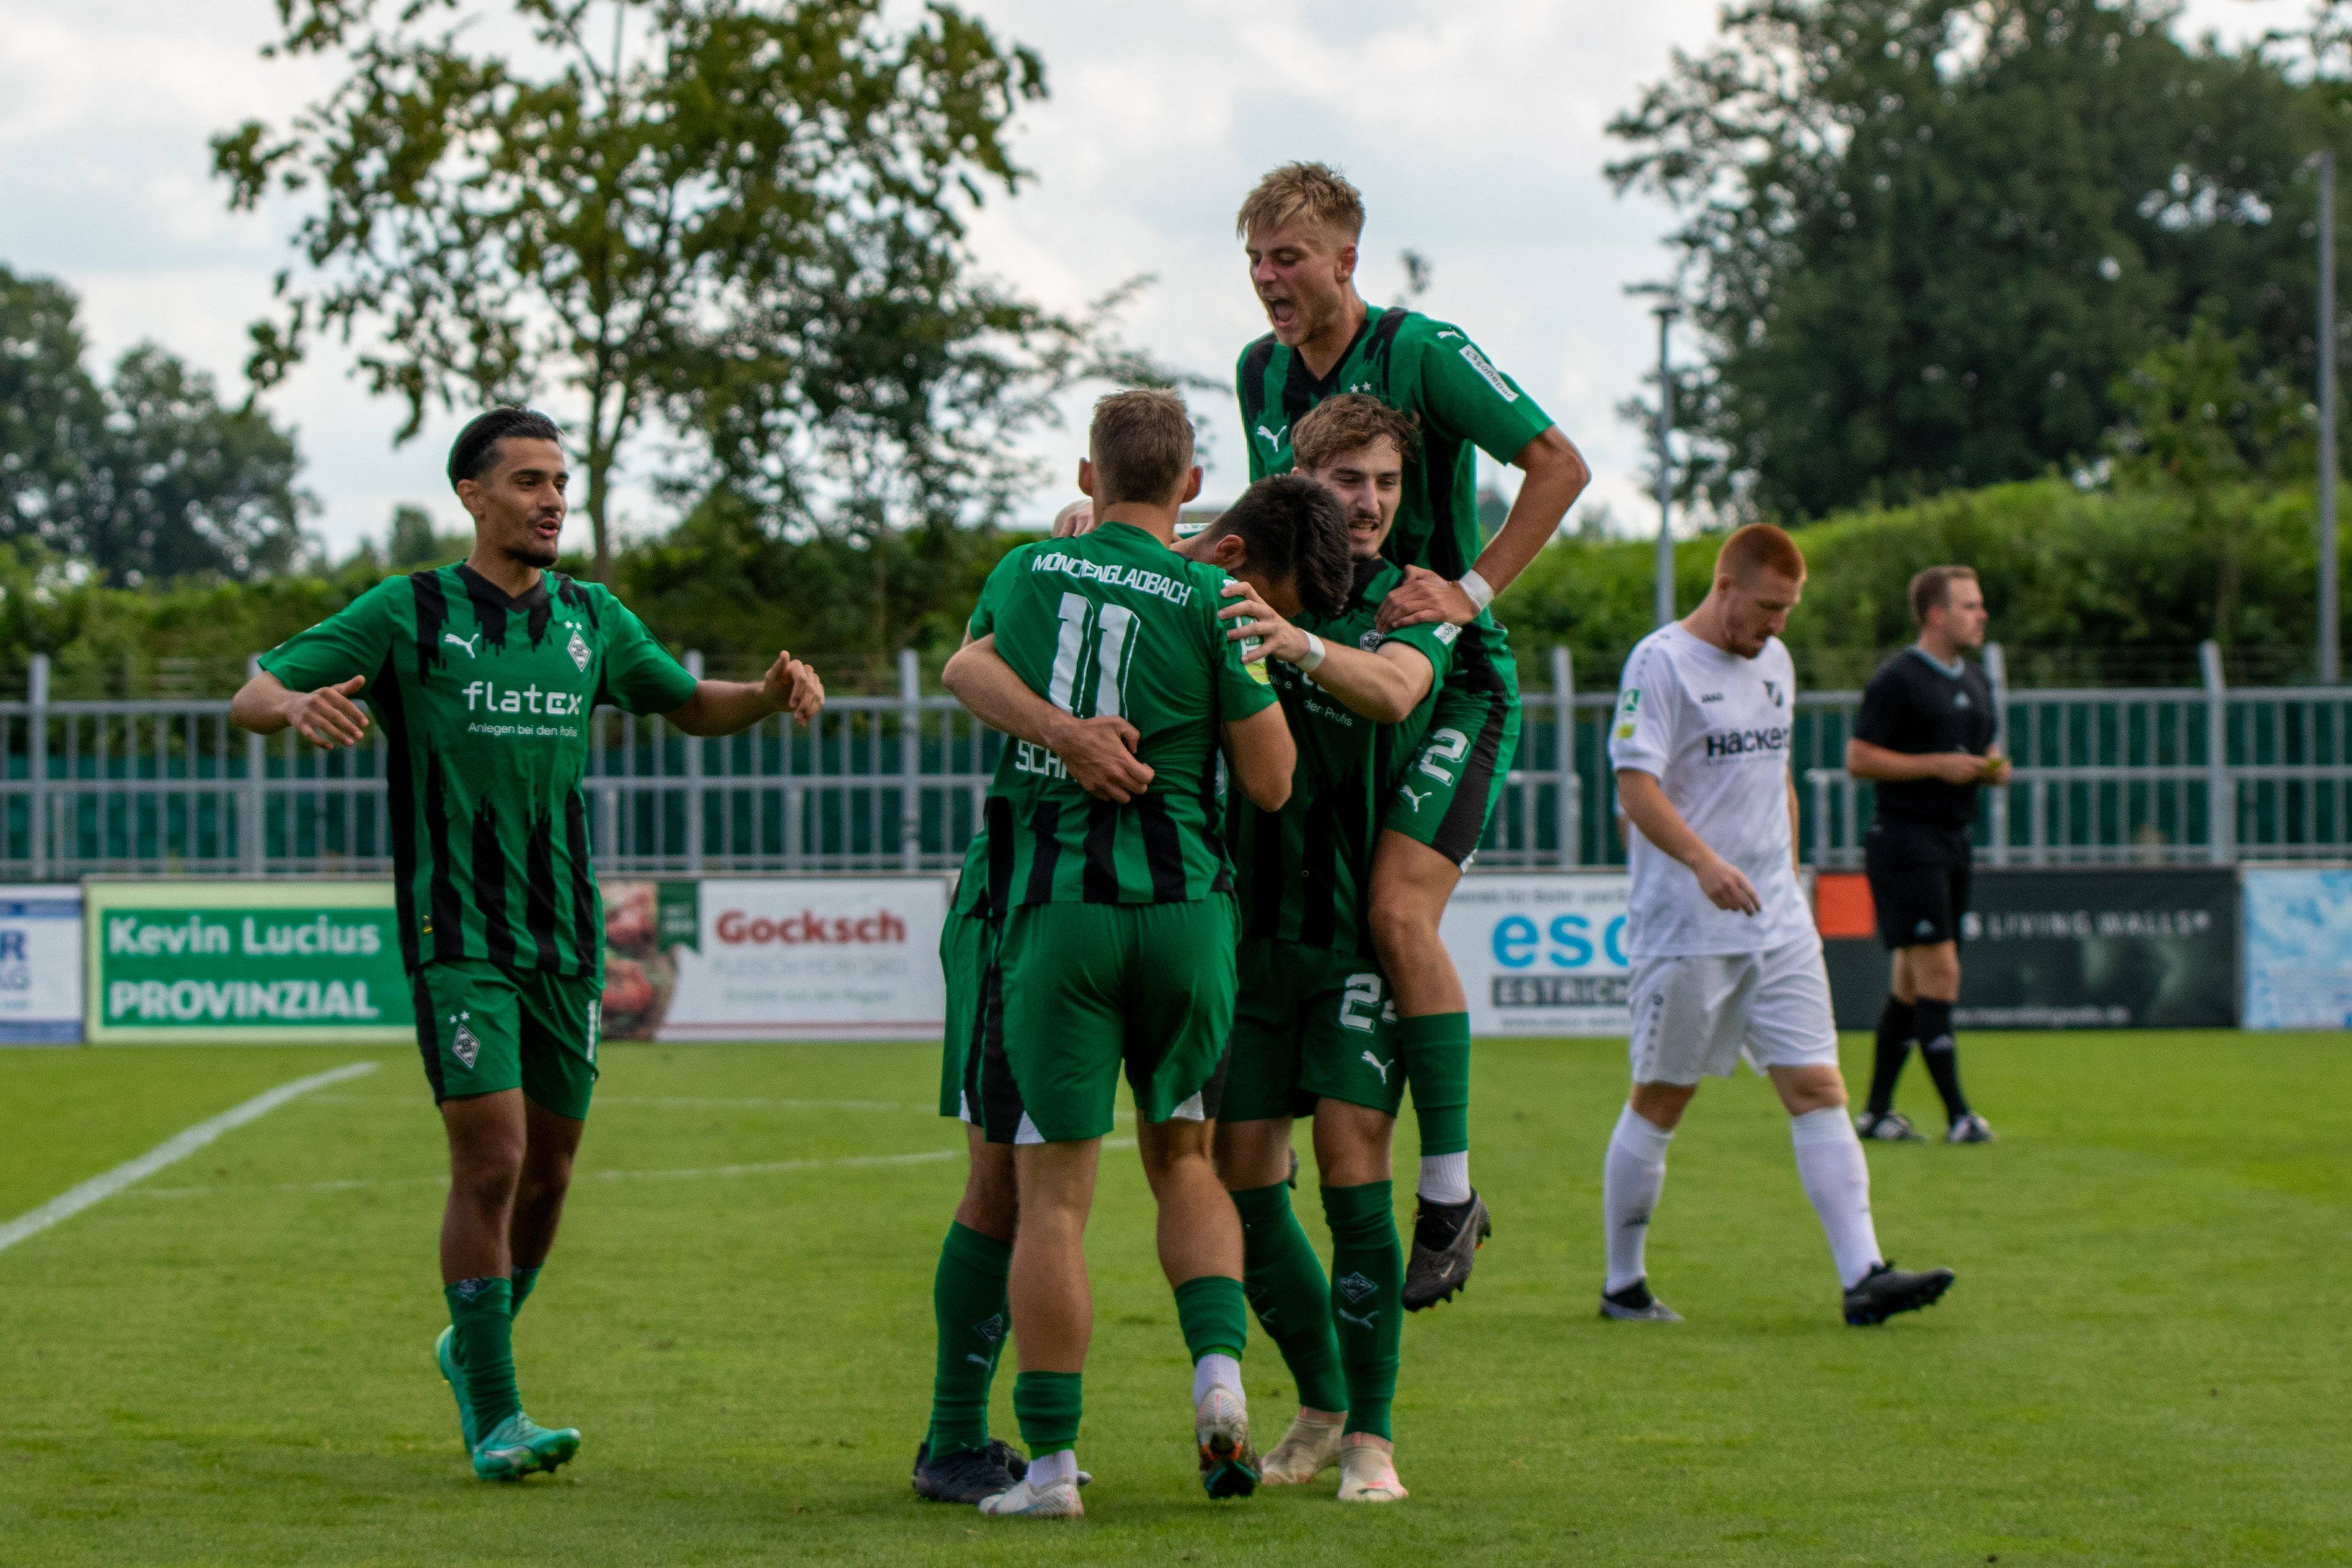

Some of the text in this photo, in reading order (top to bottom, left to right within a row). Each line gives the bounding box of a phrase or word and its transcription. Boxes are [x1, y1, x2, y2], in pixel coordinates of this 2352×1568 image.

[1031, 552, 1192, 606] MÖNCENGLADBACH
[1050, 591, 1141, 721] 11
[462, 680, 582, 715] flatex
[469, 722, 515, 735] Anlegen
[517, 724, 534, 735] bei
[536, 726, 558, 735] den
[1324, 707, 1352, 727] Profis
[109, 915, 381, 956] Kevin Lucius
[715, 908, 907, 945] Gocksch
[109, 980, 381, 1019] PROVINZIAL
